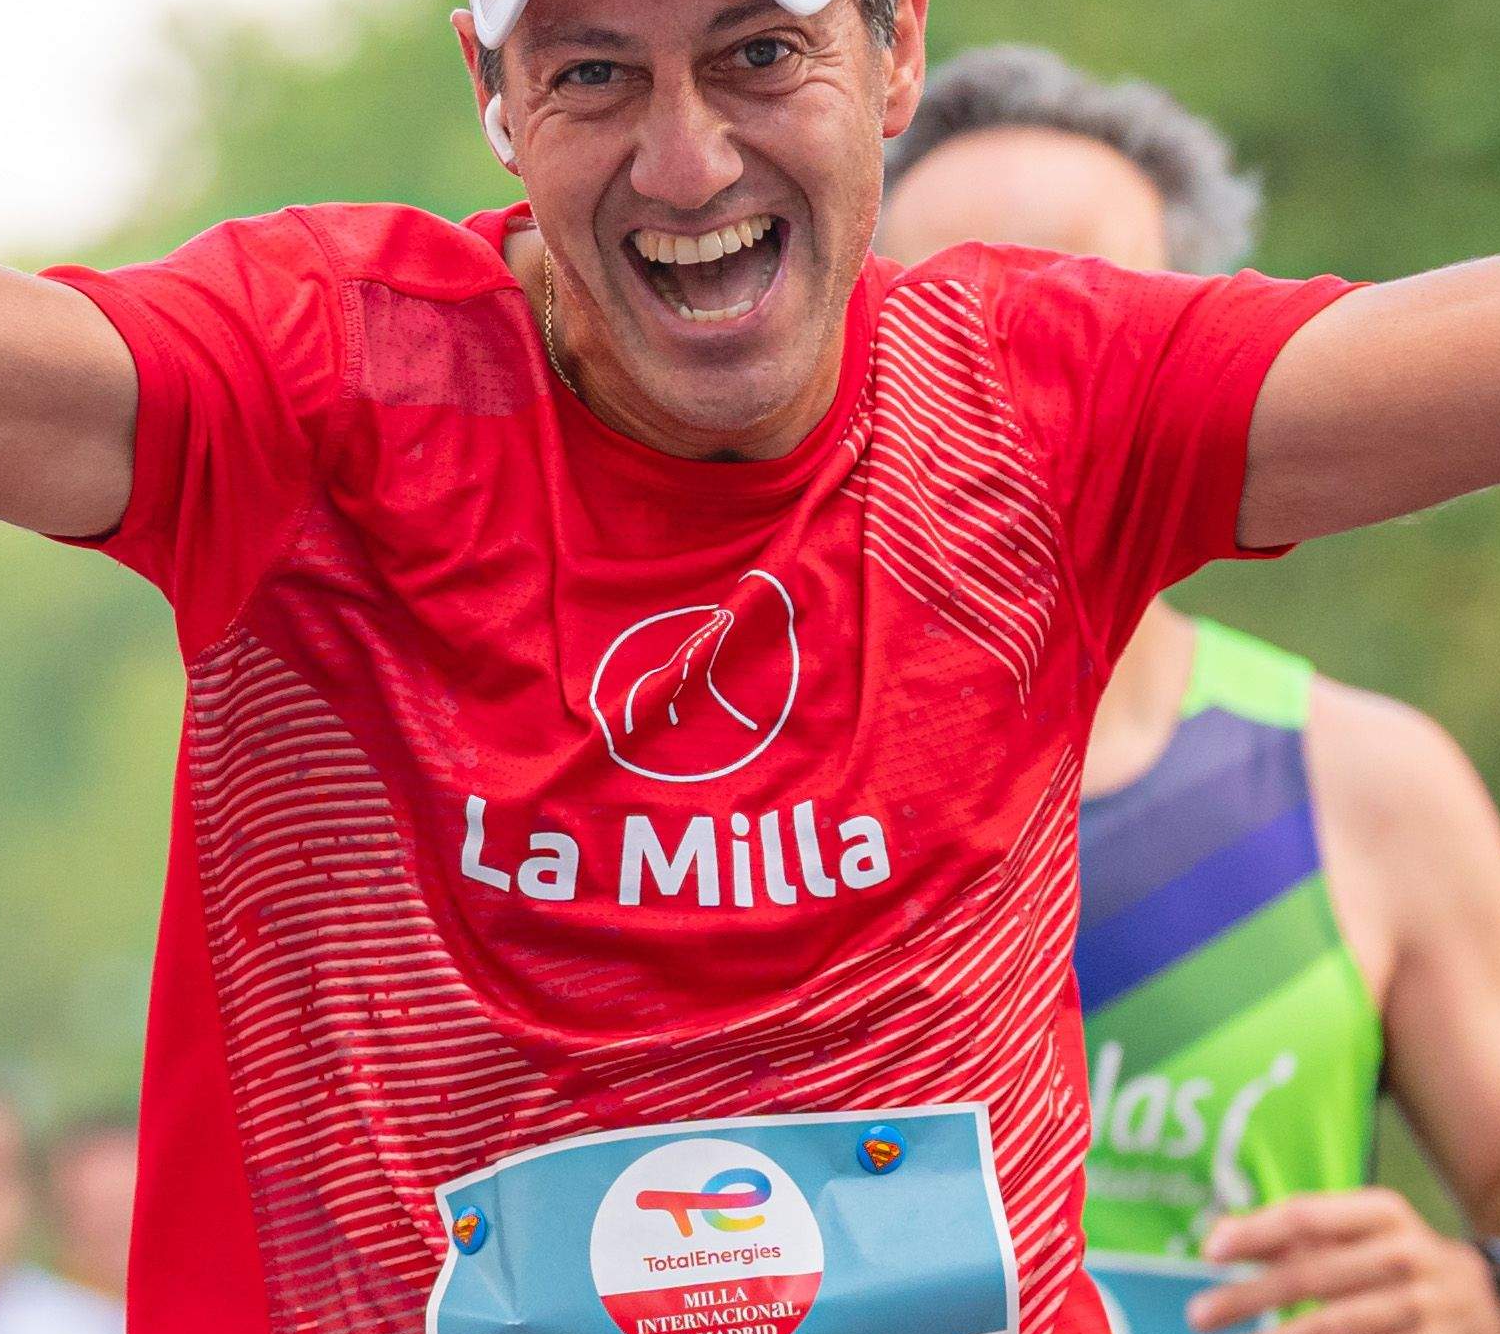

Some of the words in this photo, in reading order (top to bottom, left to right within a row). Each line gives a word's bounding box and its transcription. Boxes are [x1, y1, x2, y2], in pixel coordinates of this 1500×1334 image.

[461, 794, 580, 901] La
[618, 799, 892, 908] Milla
[1088, 1040, 1212, 1158] las
[643, 1243, 781, 1272] TotalEnergies
[683, 1286, 748, 1308] MILLA
